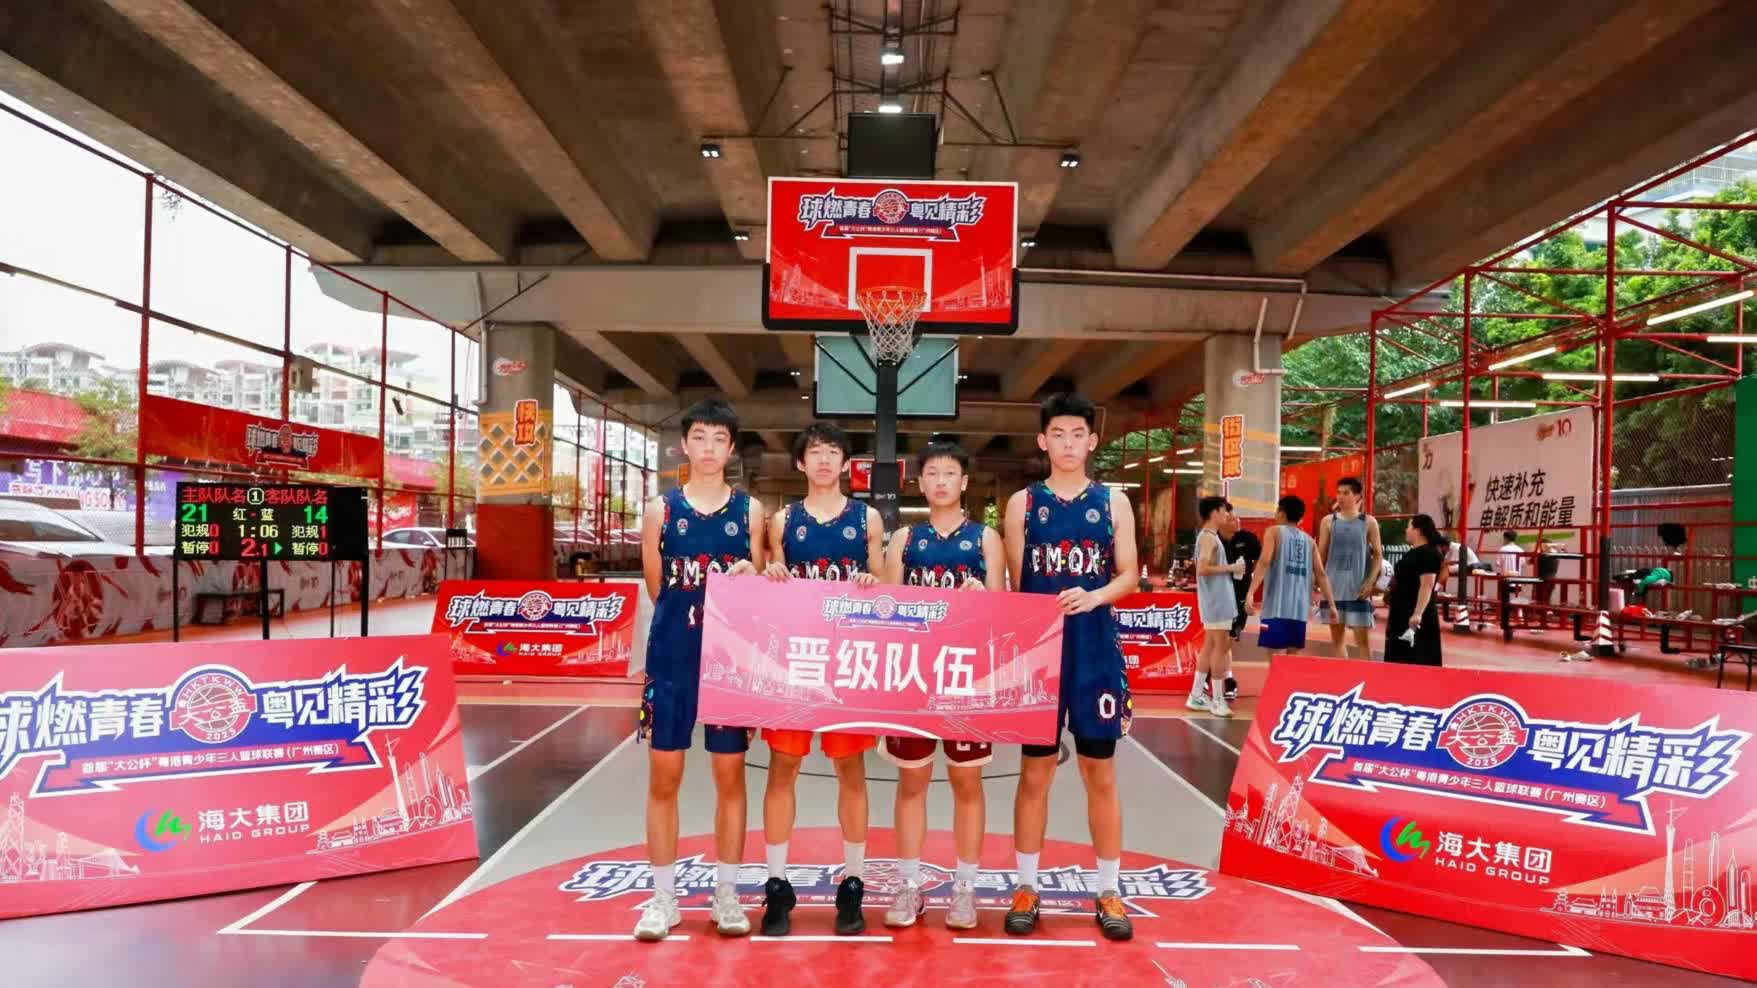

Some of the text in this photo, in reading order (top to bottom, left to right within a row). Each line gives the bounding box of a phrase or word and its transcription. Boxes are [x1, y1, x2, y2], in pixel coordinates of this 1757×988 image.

[802, 196, 985, 225] 球燃青春 粤见精彩
[182, 488, 246, 504] 主队队名
[266, 489, 328, 504] 客队队名
[1484, 468, 1547, 503] 快速补充
[181, 504, 208, 522] 21
[232, 507, 247, 521] 红
[261, 508, 274, 521] 蓝
[304, 505, 328, 523] 14
[1479, 496, 1576, 532] 电解质和能量
[239, 524, 279, 538] 1:06
[241, 538, 268, 557] 2.1
[451, 599, 623, 623] 球燃青春 粤见精彩
[785, 636, 978, 697] 晋级队伍
[260, 677, 422, 731] 粤见精彩
[206, 727, 237, 740] 2025
[1279, 696, 1739, 790] 球燃青春 粤见精彩
[1466, 757, 1498, 766] 2025
[198, 801, 309, 832] 海大集团
[200, 823, 310, 844] HAID GROUP
[1435, 831, 1552, 873] 海大集团
[1435, 856, 1550, 885] HAID GROUP
